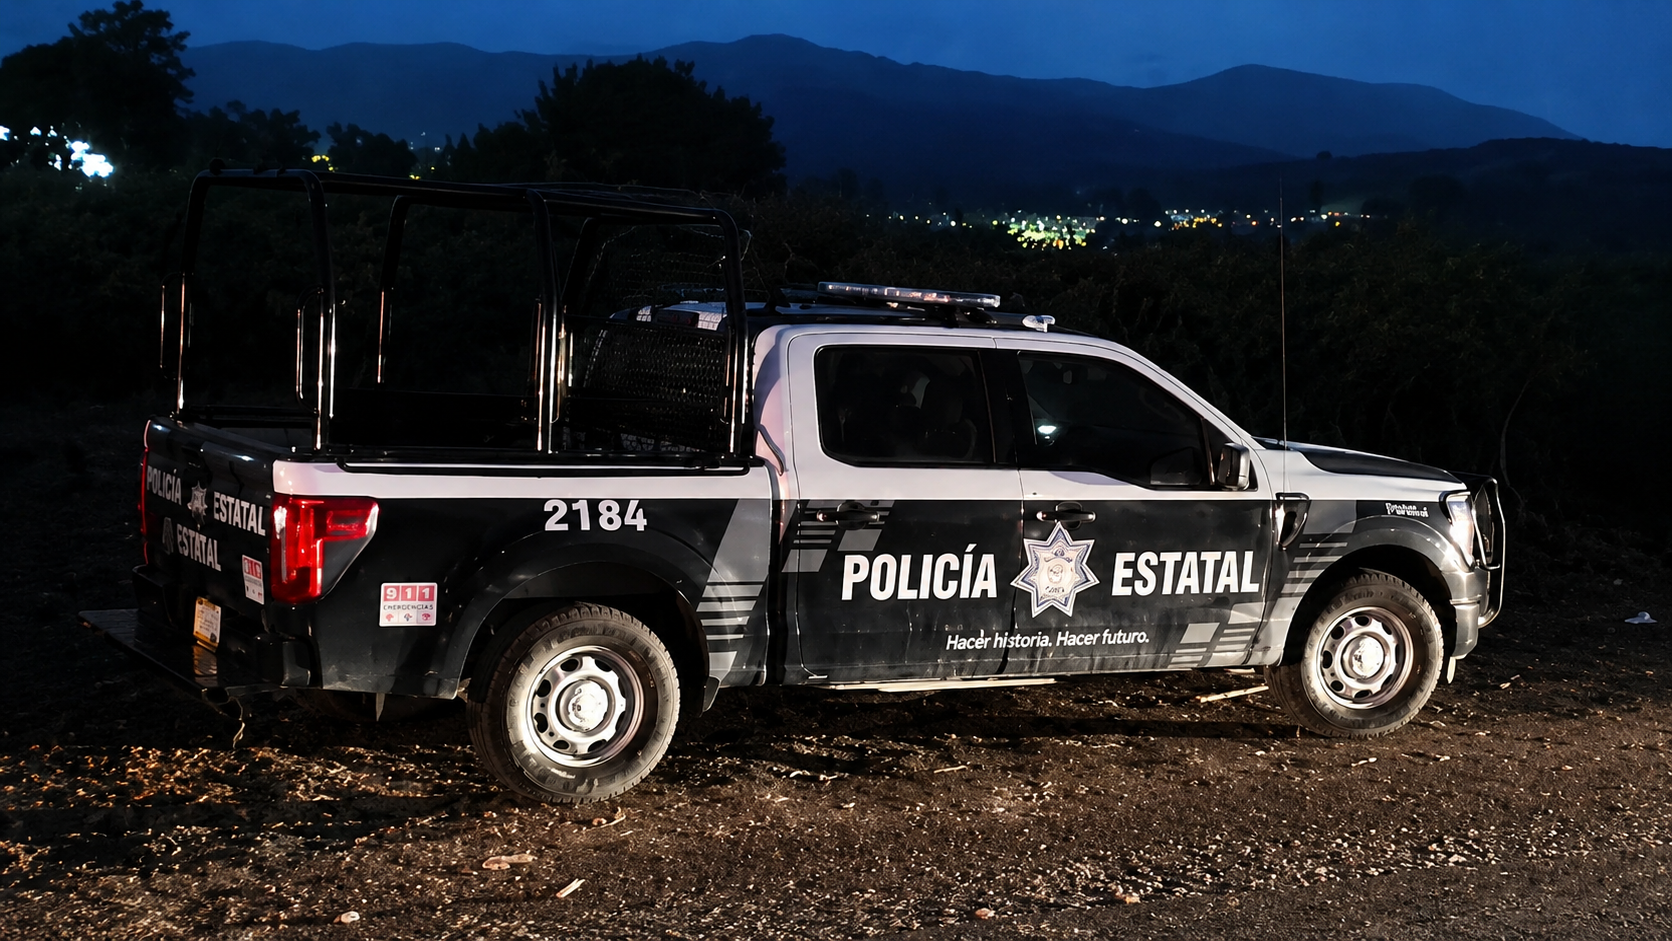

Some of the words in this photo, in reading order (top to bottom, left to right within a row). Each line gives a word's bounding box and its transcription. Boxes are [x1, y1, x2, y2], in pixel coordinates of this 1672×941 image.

[146, 465, 182, 506] POLICÍA
[213, 491, 267, 537] ESTATAL
[543, 498, 648, 532] 2184
[841, 543, 998, 601] POLICÍA
[1111, 550, 1260, 597] ESTATAL
[386, 587, 431, 600] 911
[945, 633, 991, 650] Hacer
[993, 631, 1053, 649] historia.
[1055, 631, 1101, 647] Hacer
[1101, 628, 1150, 644] futuro.
